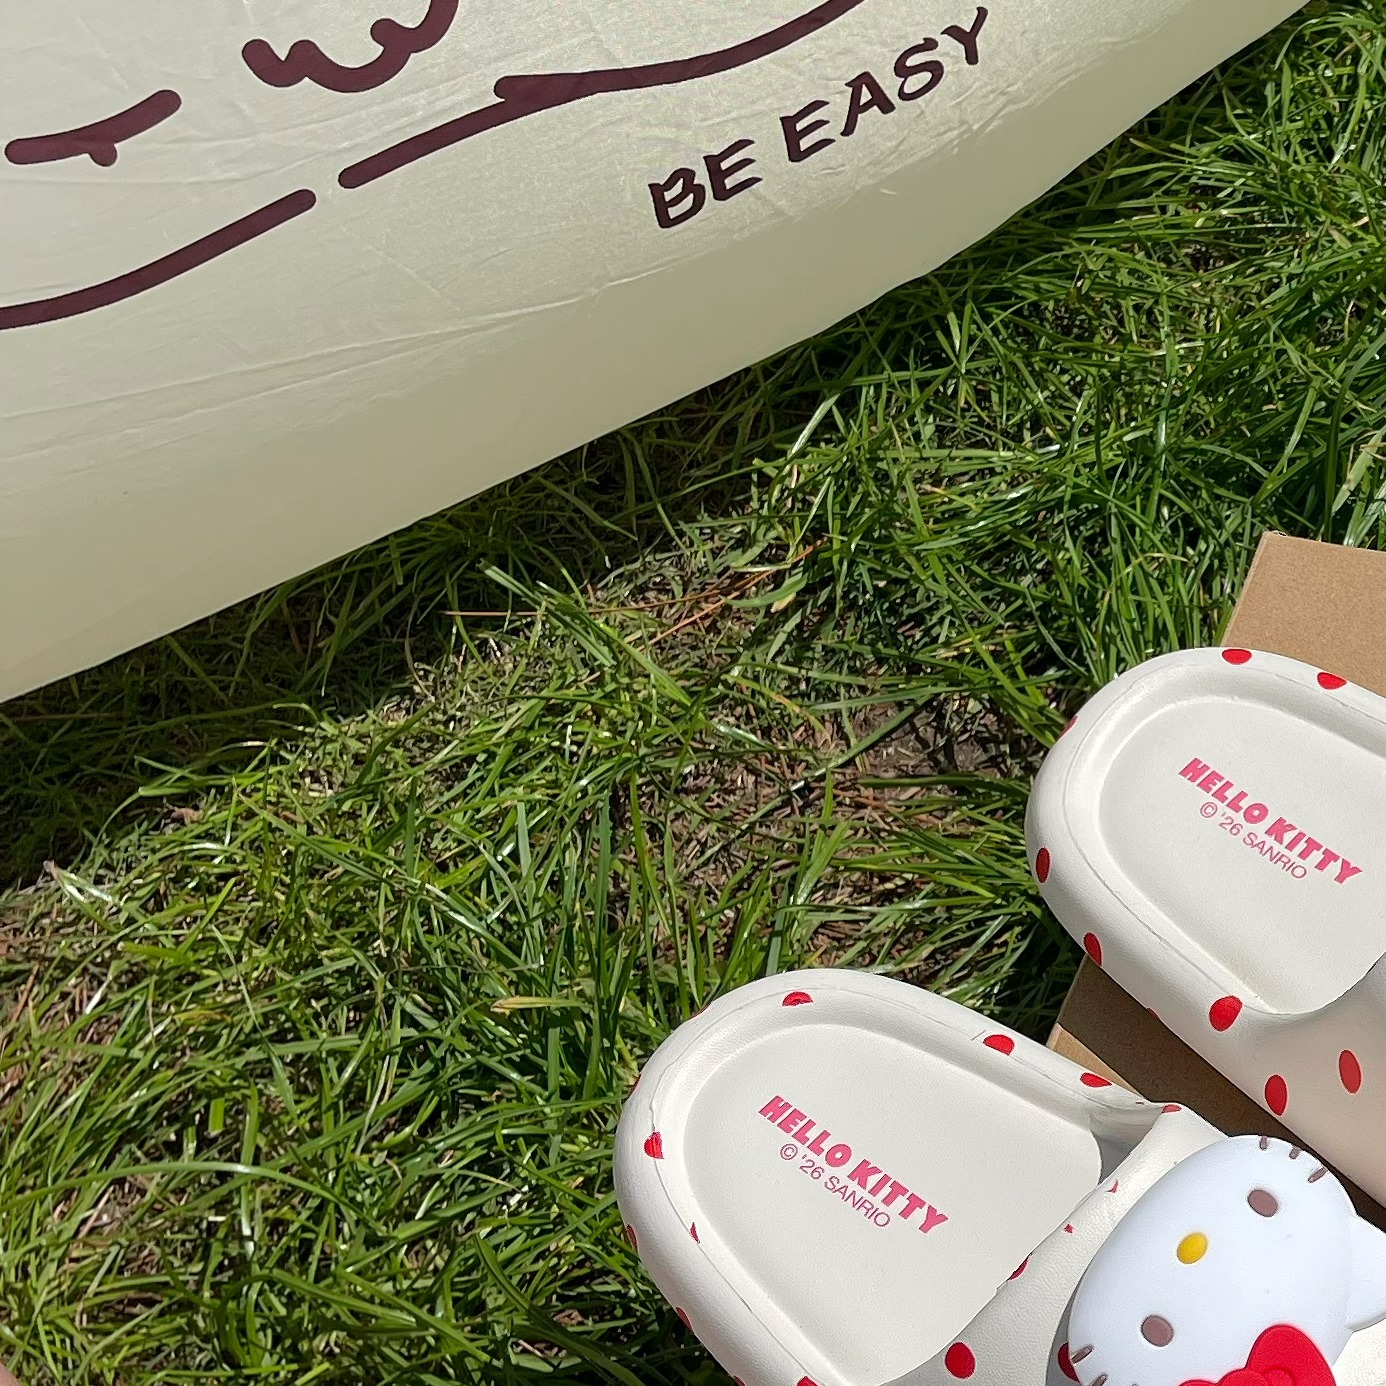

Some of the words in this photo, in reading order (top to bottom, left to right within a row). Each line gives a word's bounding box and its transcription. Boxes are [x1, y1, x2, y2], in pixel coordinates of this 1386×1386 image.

[648, 138, 763, 229] BE
[779, 6, 989, 163] EASY
[1178, 757, 1269, 824] HELLO
[1264, 816, 1363, 884] KITTY
[1243, 832, 1307, 879] SANRIO
[758, 1095, 853, 1168] HELLO
[847, 1159, 949, 1234] KITTY
[824, 1175, 891, 1228] SANRIO
